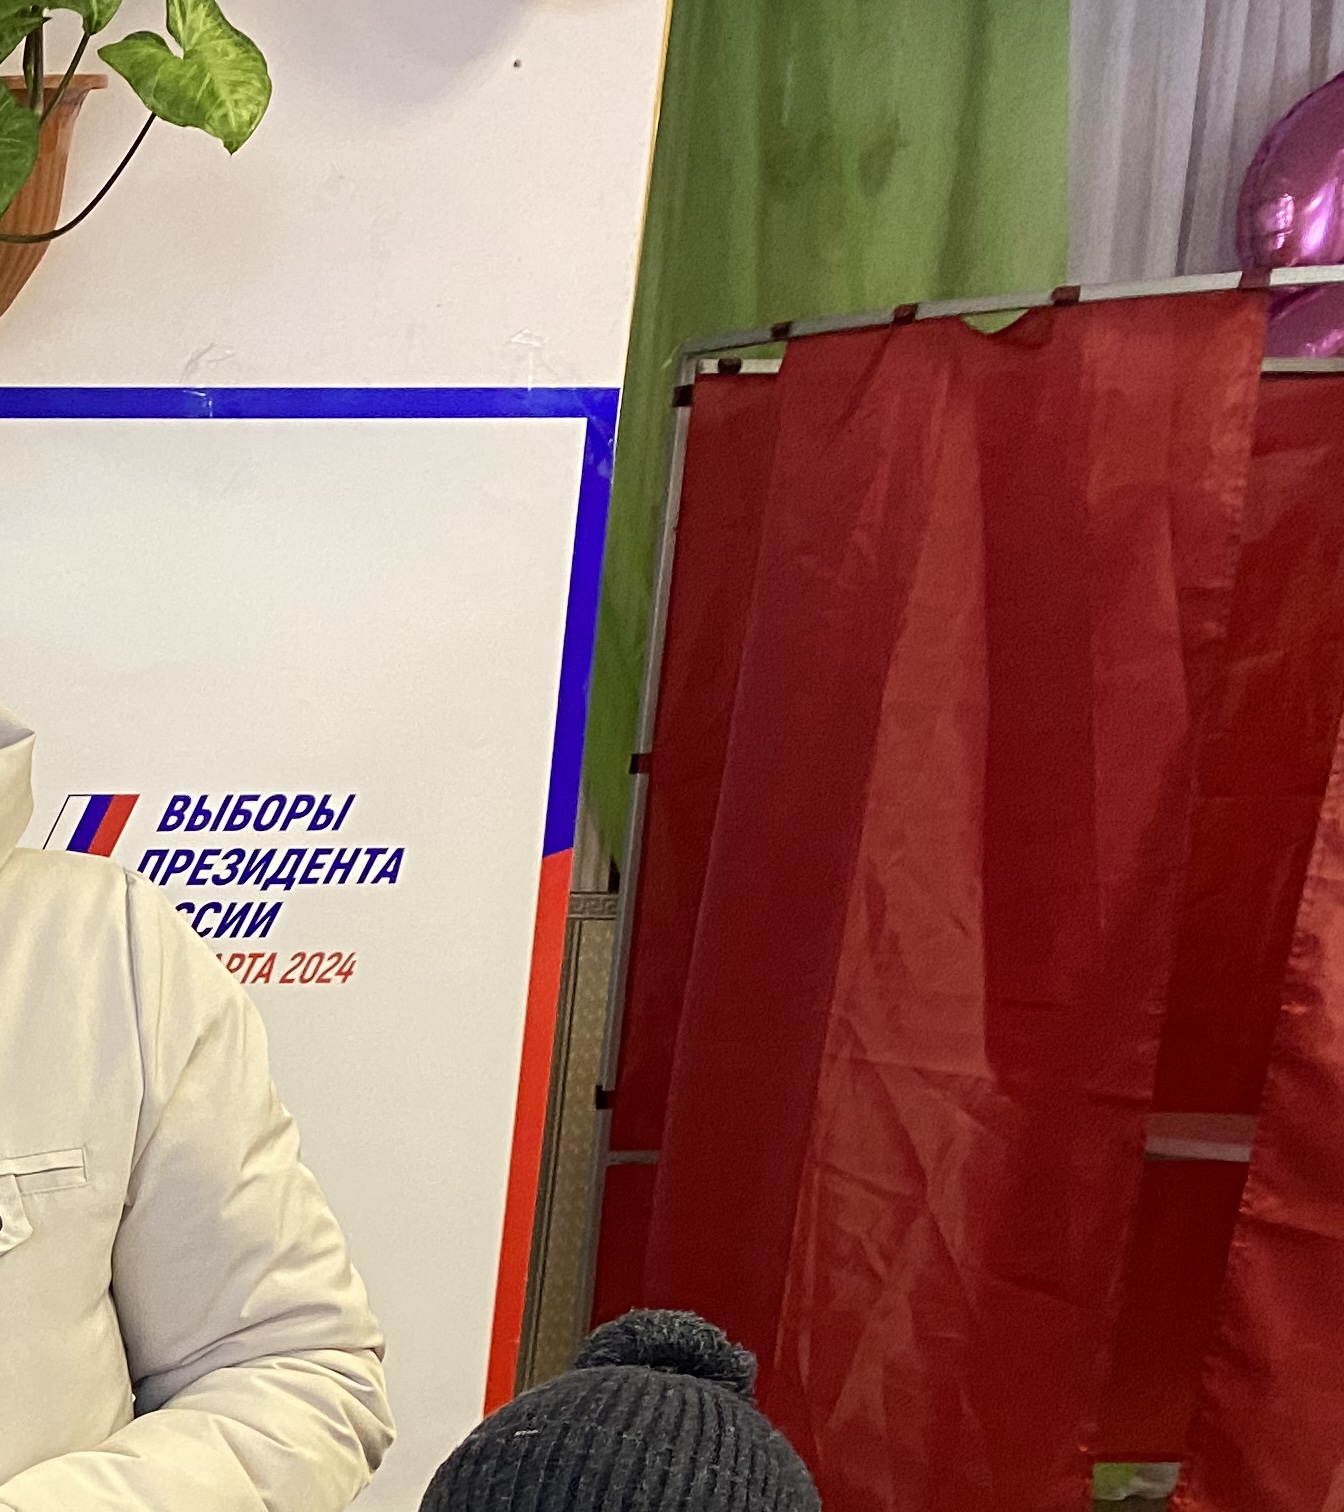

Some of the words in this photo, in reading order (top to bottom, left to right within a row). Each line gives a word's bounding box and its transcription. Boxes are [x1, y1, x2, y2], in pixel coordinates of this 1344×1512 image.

[156, 794, 357, 832] ВЫБОРЫ
[137, 847, 405, 891] ПРЕЗИДЕНТА
[216, 952, 277, 984] РТА
[279, 951, 358, 984] 2024
